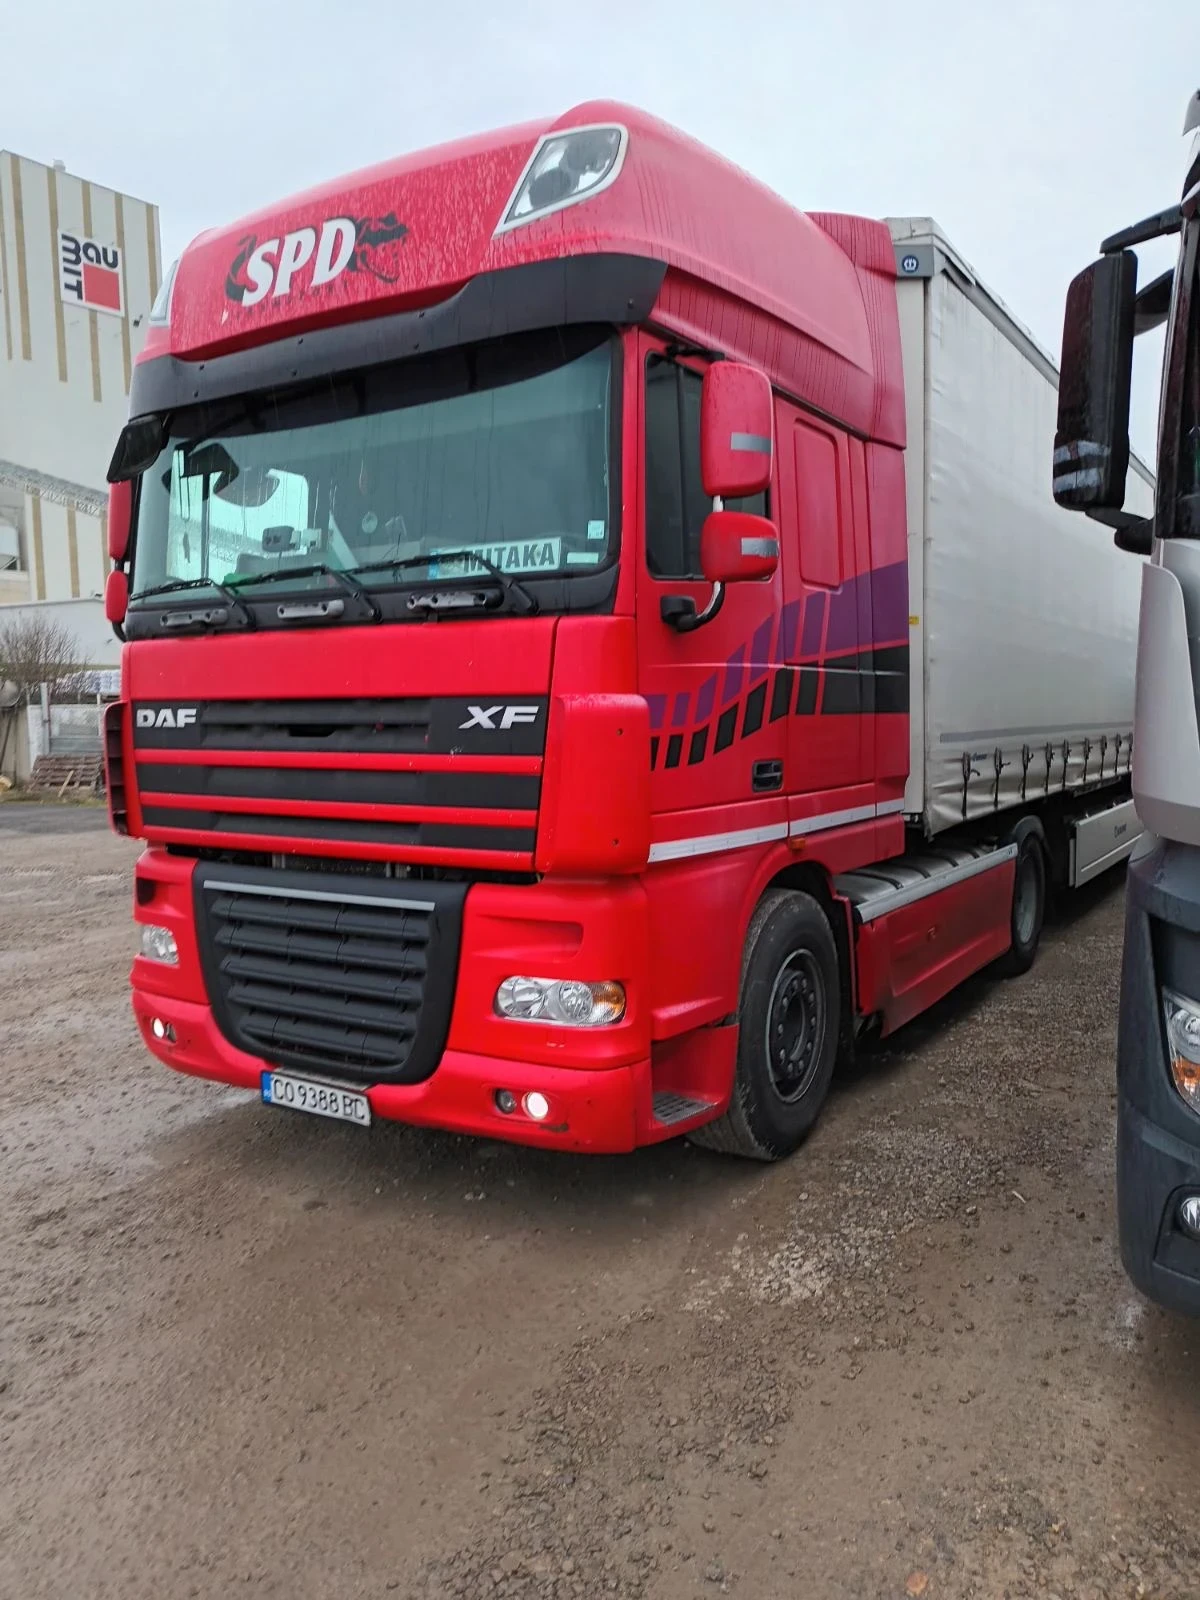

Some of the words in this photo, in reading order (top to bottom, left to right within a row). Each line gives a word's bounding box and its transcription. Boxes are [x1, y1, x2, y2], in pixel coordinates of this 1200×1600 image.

[242, 218, 356, 307] SPD
[136, 708, 197, 728] DAF
[458, 706, 539, 729] XF
